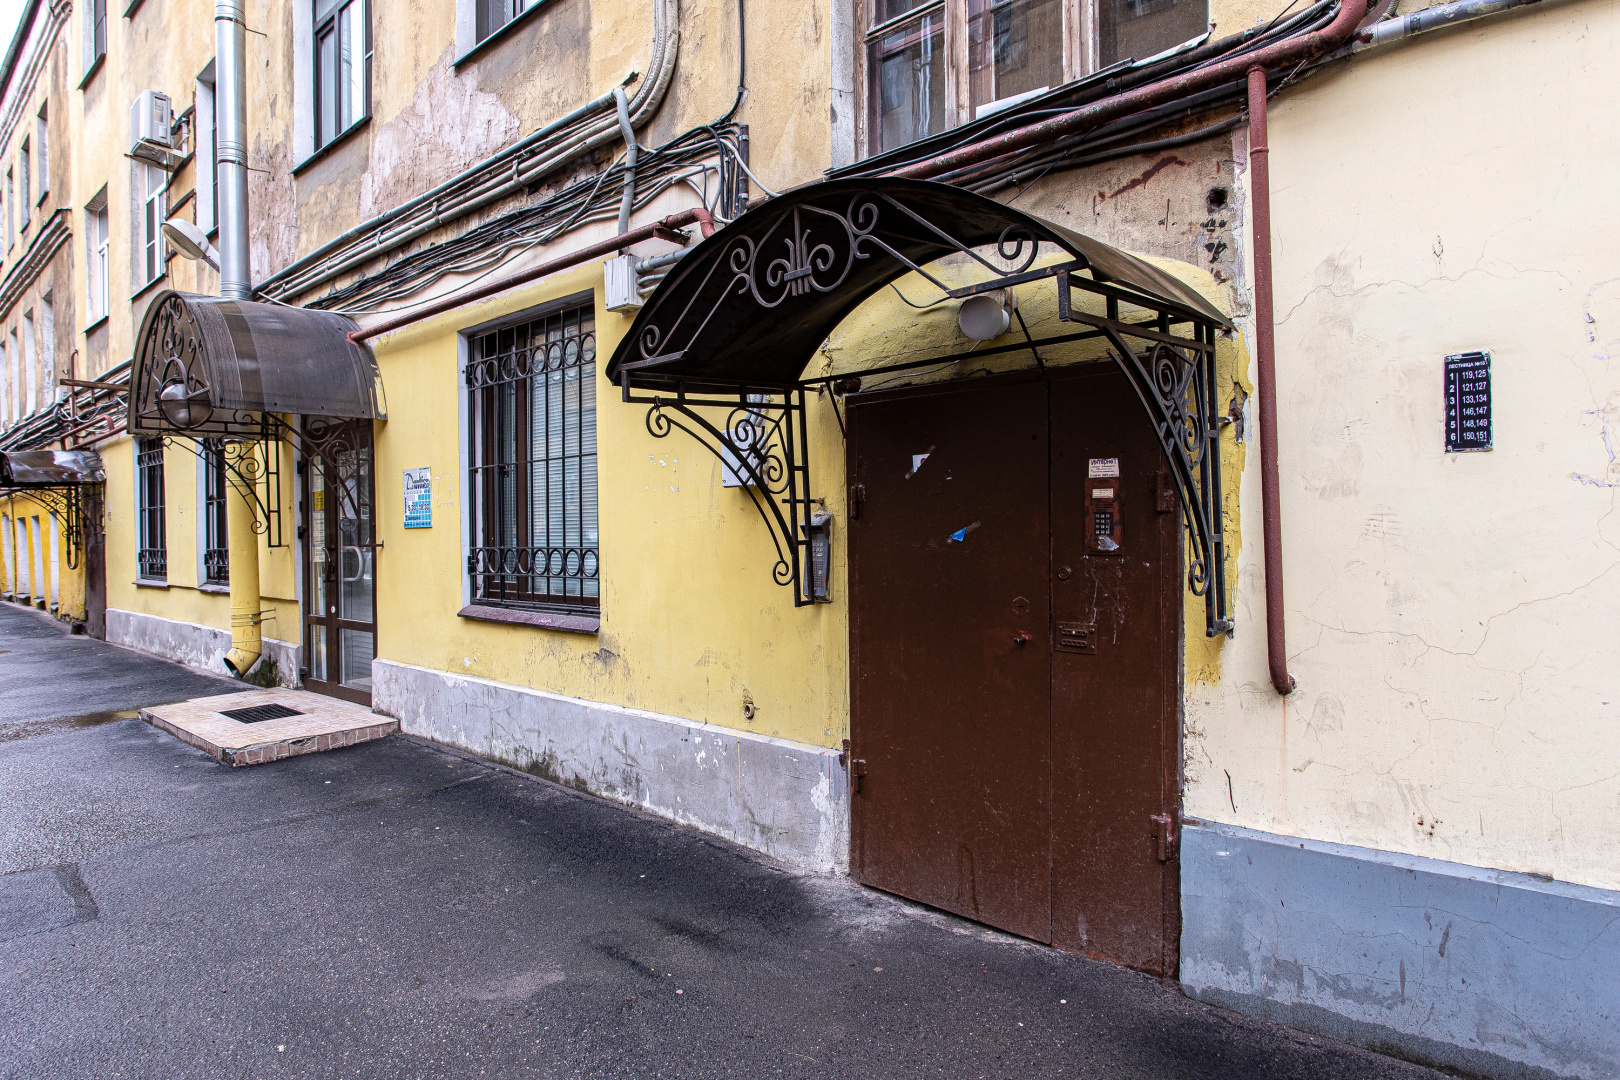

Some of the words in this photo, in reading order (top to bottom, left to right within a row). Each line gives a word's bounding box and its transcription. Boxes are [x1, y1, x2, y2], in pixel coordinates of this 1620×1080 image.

[1449, 372, 1455, 381] 1
[1449, 384, 1455, 393] 2
[1449, 396, 1455, 405] 3
[1449, 408, 1456, 417] 4
[1450, 420, 1456, 429] 5
[1450, 432, 1456, 441] 6
